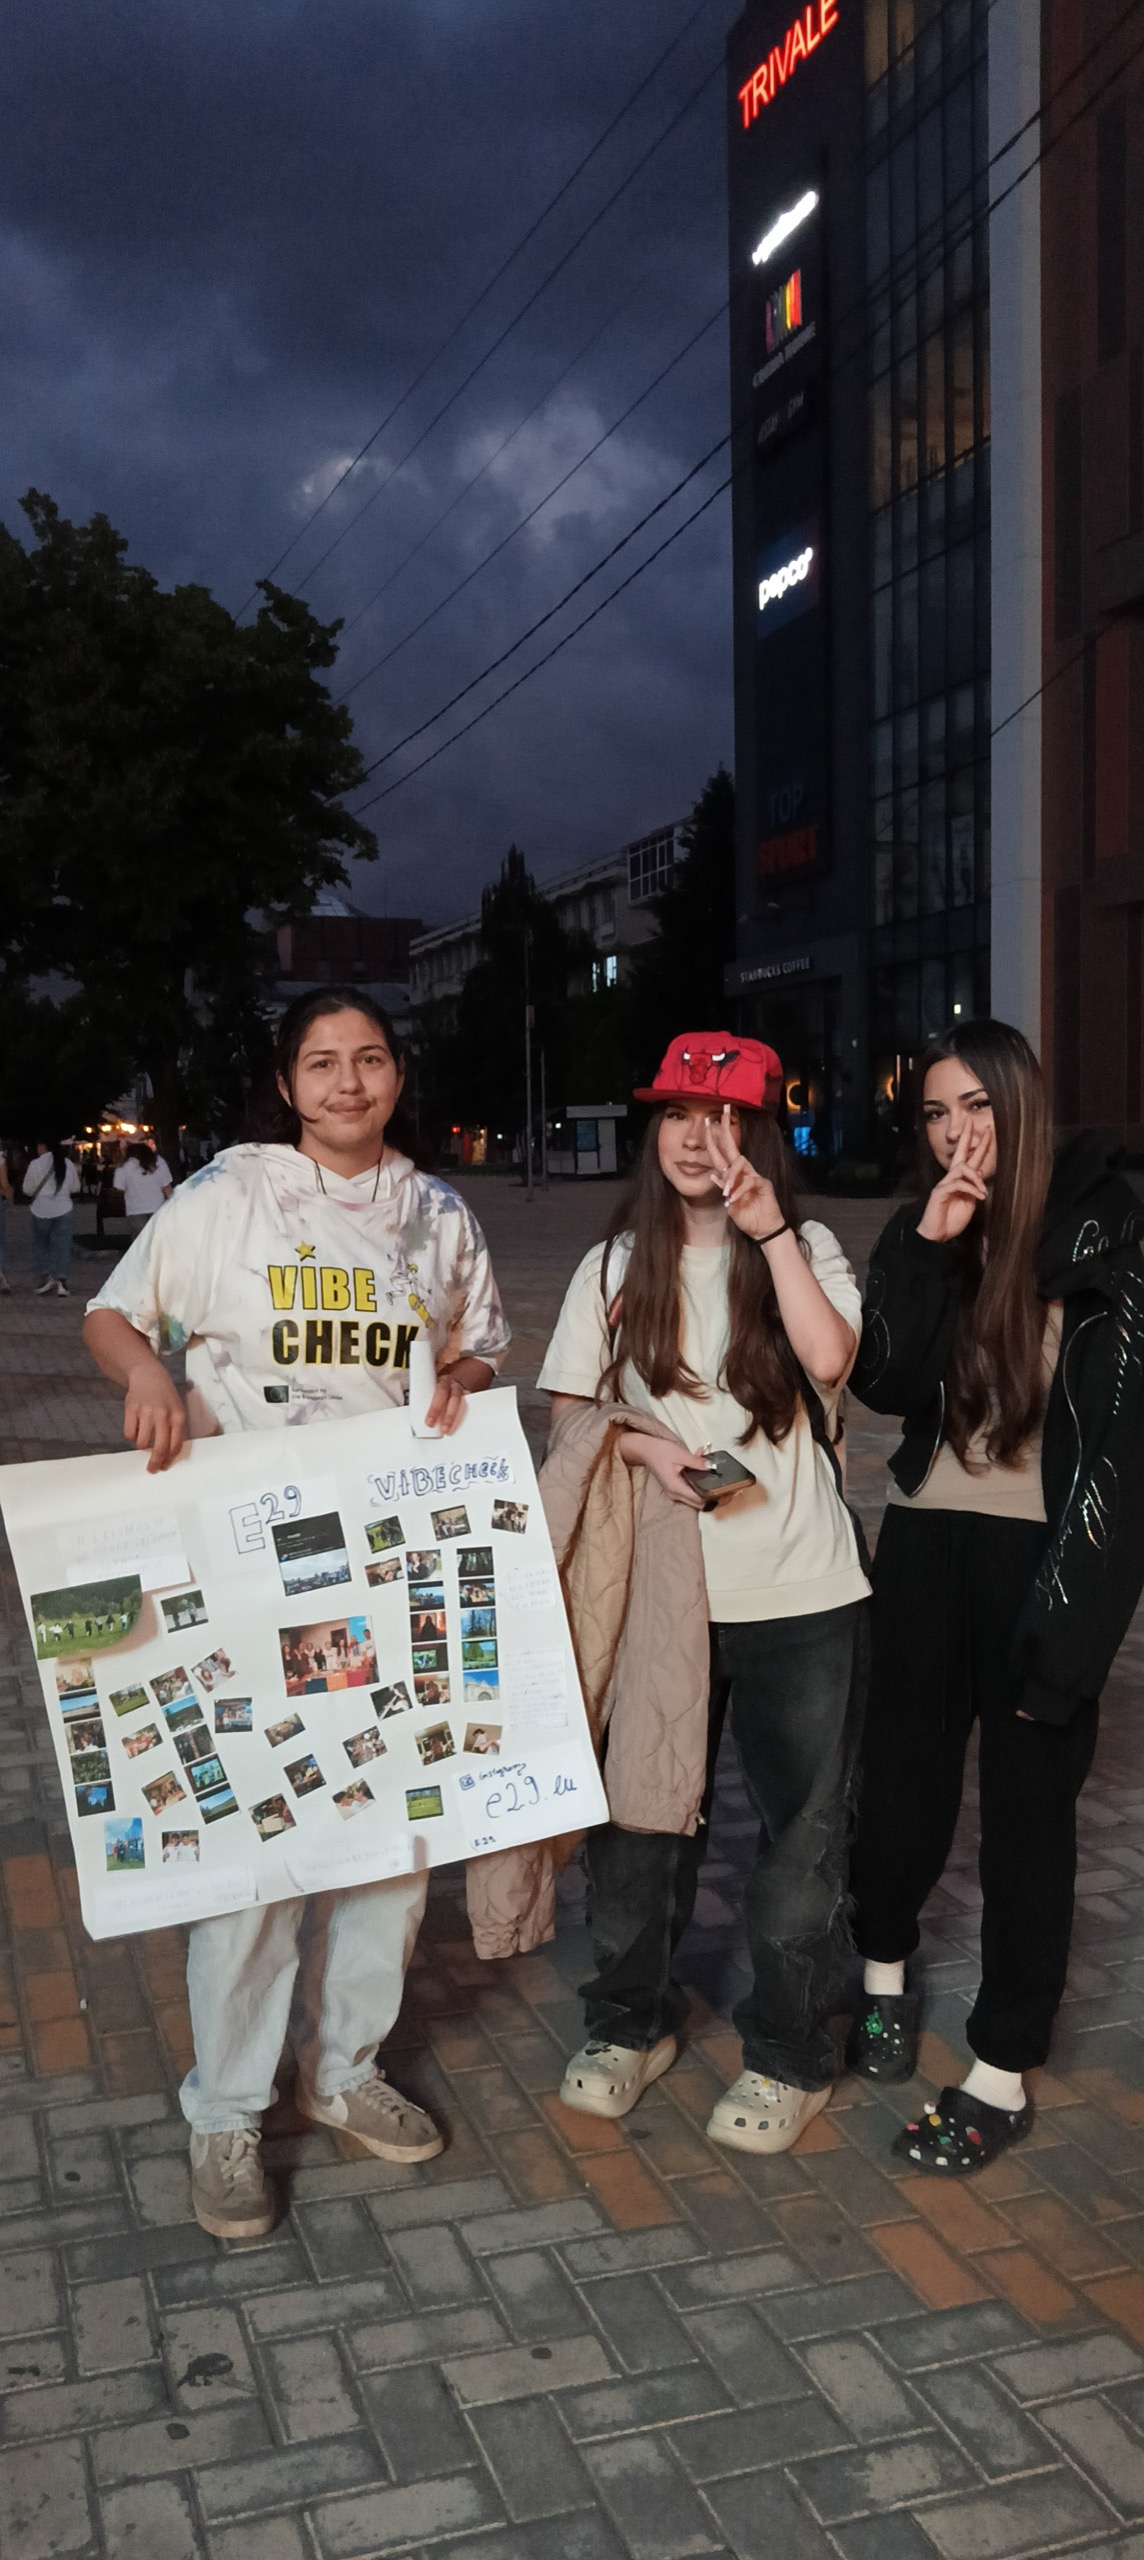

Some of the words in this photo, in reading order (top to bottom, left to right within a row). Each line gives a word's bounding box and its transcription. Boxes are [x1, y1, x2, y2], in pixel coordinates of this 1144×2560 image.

[737, 0, 839, 129] TRIVALE
[759, 548, 812, 610] pepco
[268, 1265, 377, 1312] VIBE
[272, 1319, 419, 1369] CHECK
